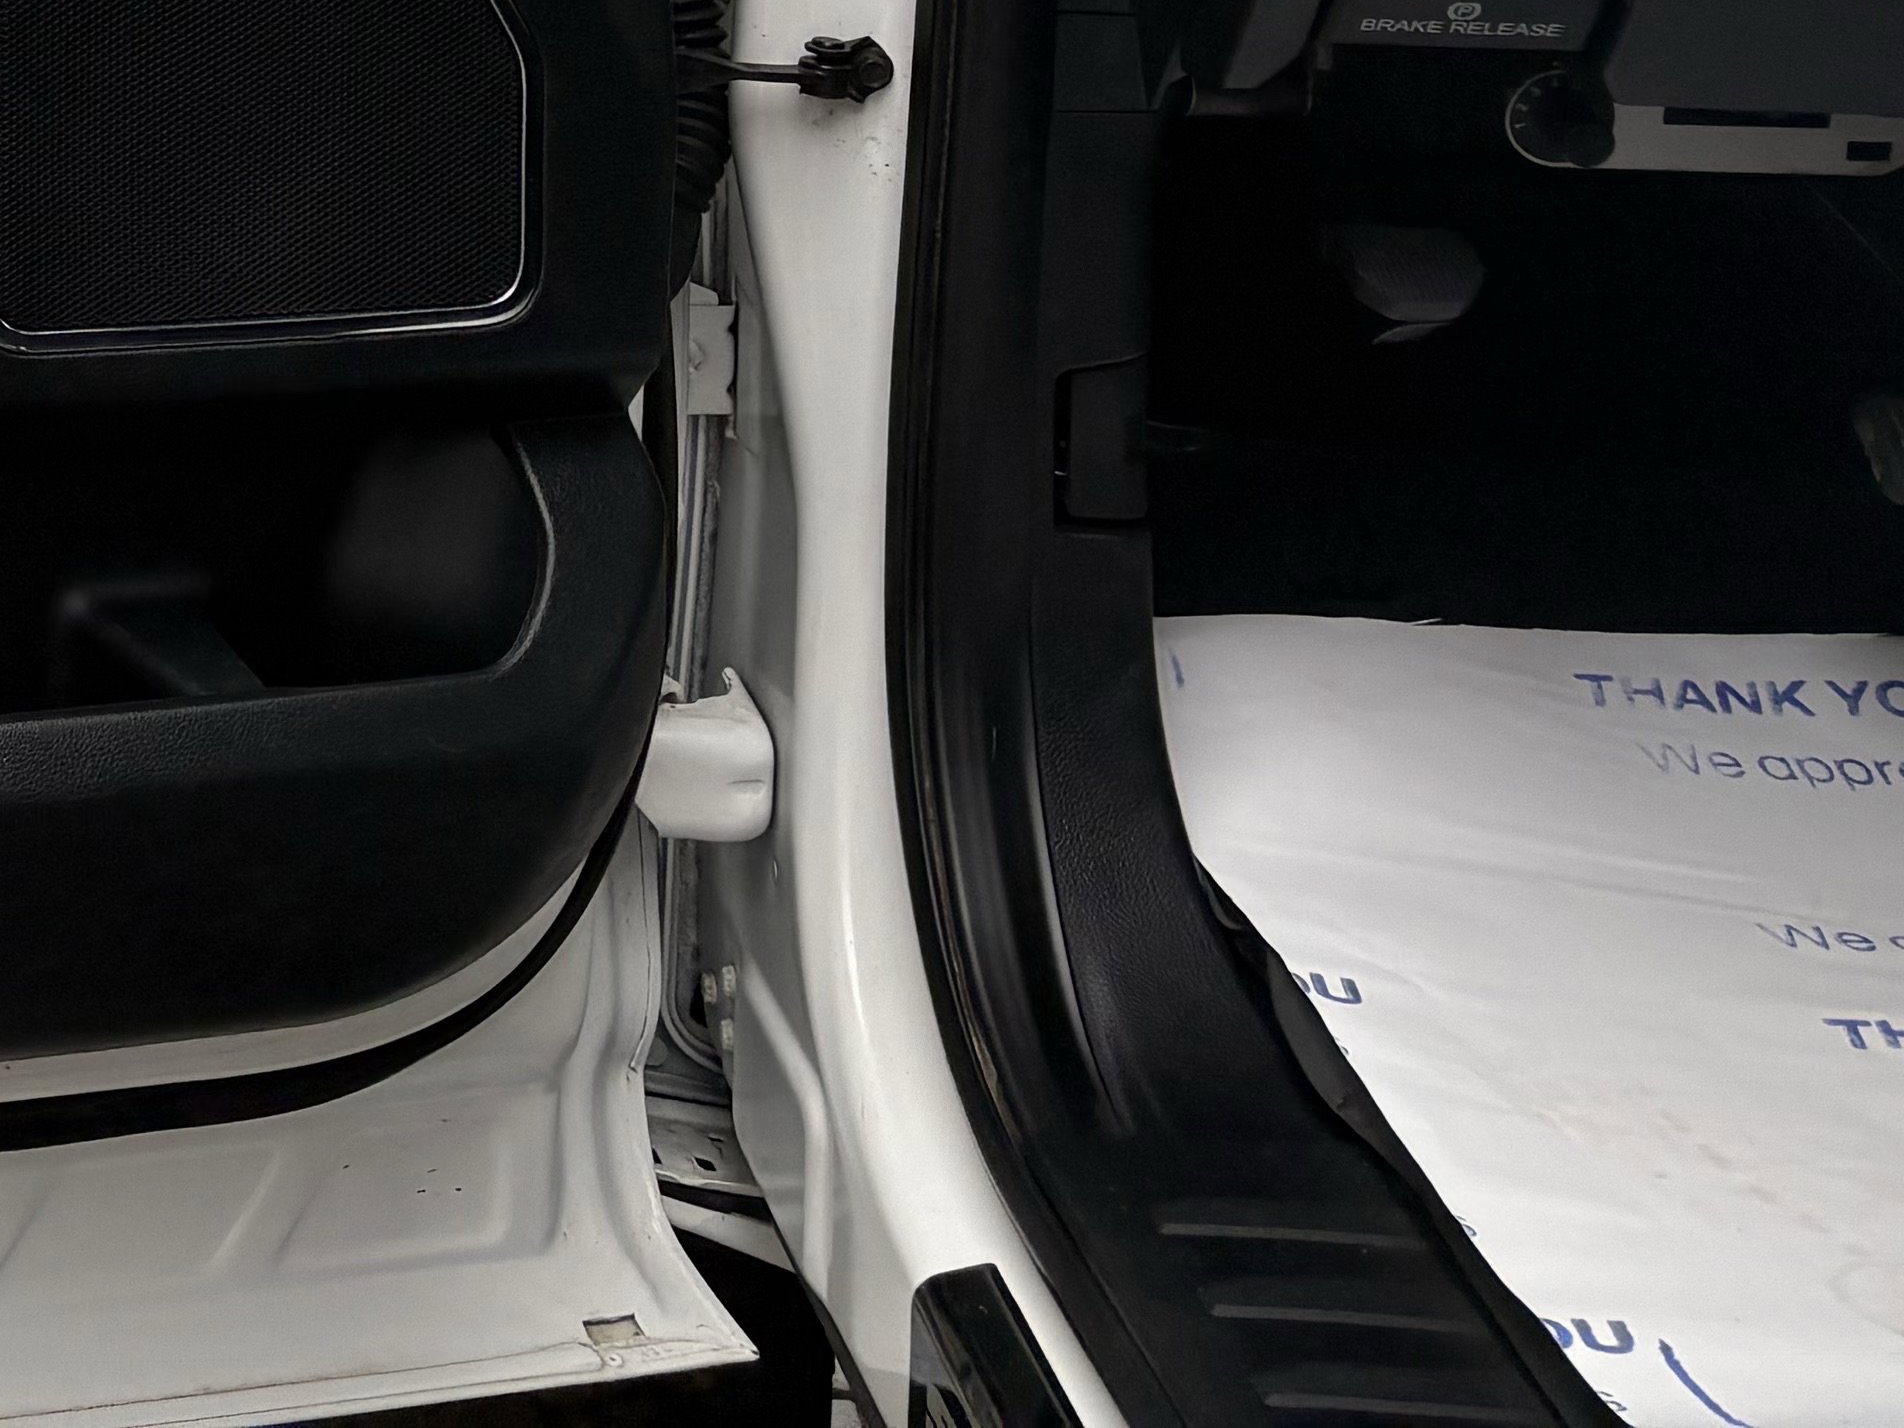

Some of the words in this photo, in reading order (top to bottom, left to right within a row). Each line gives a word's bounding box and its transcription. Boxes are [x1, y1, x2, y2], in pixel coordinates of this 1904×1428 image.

[1360, 18, 1443, 33] BRAKE
[1449, 21, 1566, 37] RELEASE
[1572, 673, 1816, 717] THANK
[1635, 742, 1746, 779] We
[1757, 755, 1904, 791] appr
[1754, 922, 1877, 952] We
